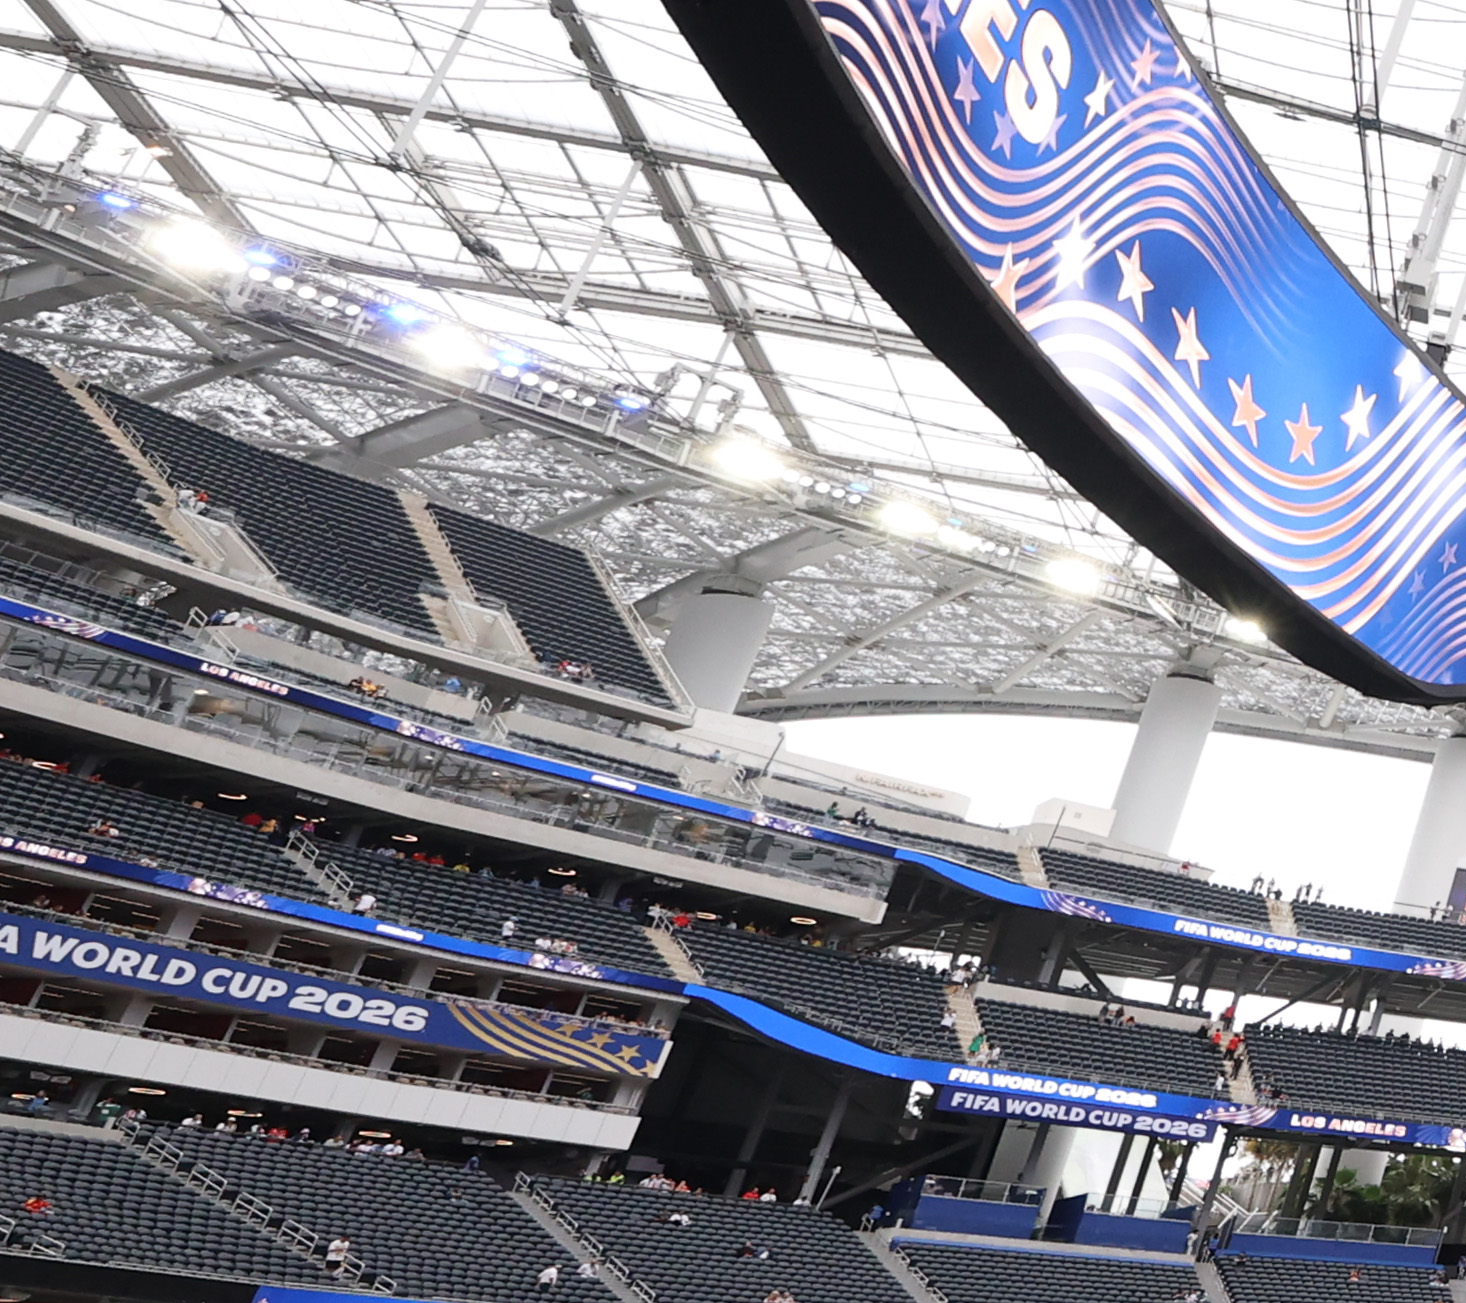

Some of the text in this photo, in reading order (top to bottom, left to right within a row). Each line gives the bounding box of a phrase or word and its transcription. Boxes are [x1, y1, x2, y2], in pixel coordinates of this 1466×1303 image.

[200, 660, 292, 695] LOS ANGELES
[14, 840, 88, 864] ANGELES
[1174, 920, 1209, 937] FIFA
[1209, 925, 1265, 947] WORLD
[1263, 936, 1298, 953] CUP
[33, 930, 196, 986] WORLD
[202, 967, 288, 1002] CUP
[288, 985, 429, 1031] 2026
[947, 1068, 991, 1086] FIFA
[991, 1073, 1059, 1095] WORLD
[1057, 1082, 1097, 1099] CUP
[950, 1092, 1208, 1138] FIFA WORLD CUP 2026
[1290, 1114, 1407, 1137] LOS ANGELES
